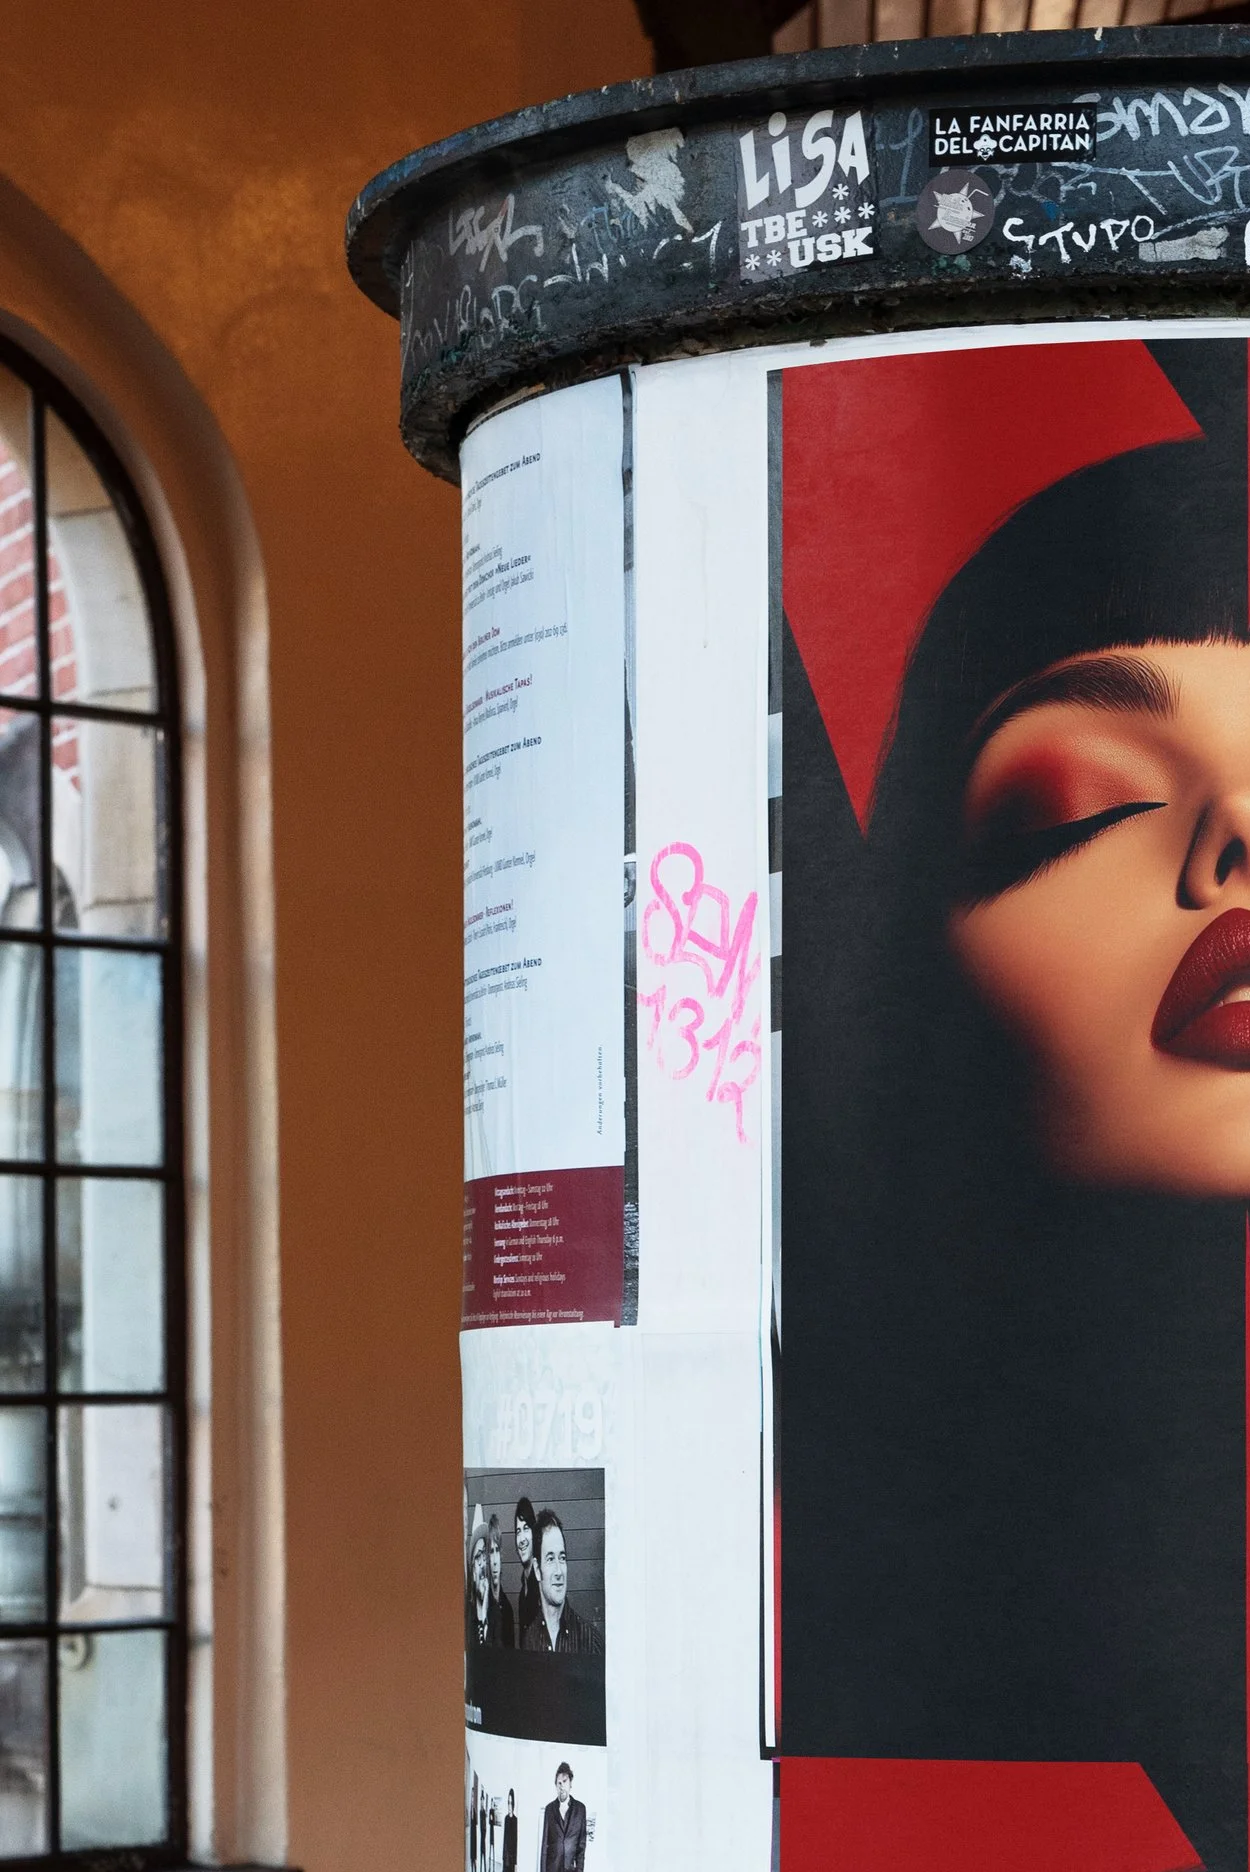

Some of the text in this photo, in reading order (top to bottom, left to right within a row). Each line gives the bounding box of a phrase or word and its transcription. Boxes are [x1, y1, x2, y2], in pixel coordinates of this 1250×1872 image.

[935, 112, 1091, 135] LA FANFARRIA
[934, 133, 1091, 156] DEL CAPITAN
[741, 209, 808, 249] TBE
[1003, 214, 1155, 264] STUPO
[787, 226, 874, 269] USK
[522, 453, 541, 467] ABEND
[515, 673, 533, 690] TAPAS!
[523, 736, 542, 748] ABEND
[511, 961, 521, 972] ZUM
[523, 957, 542, 968] ABEND
